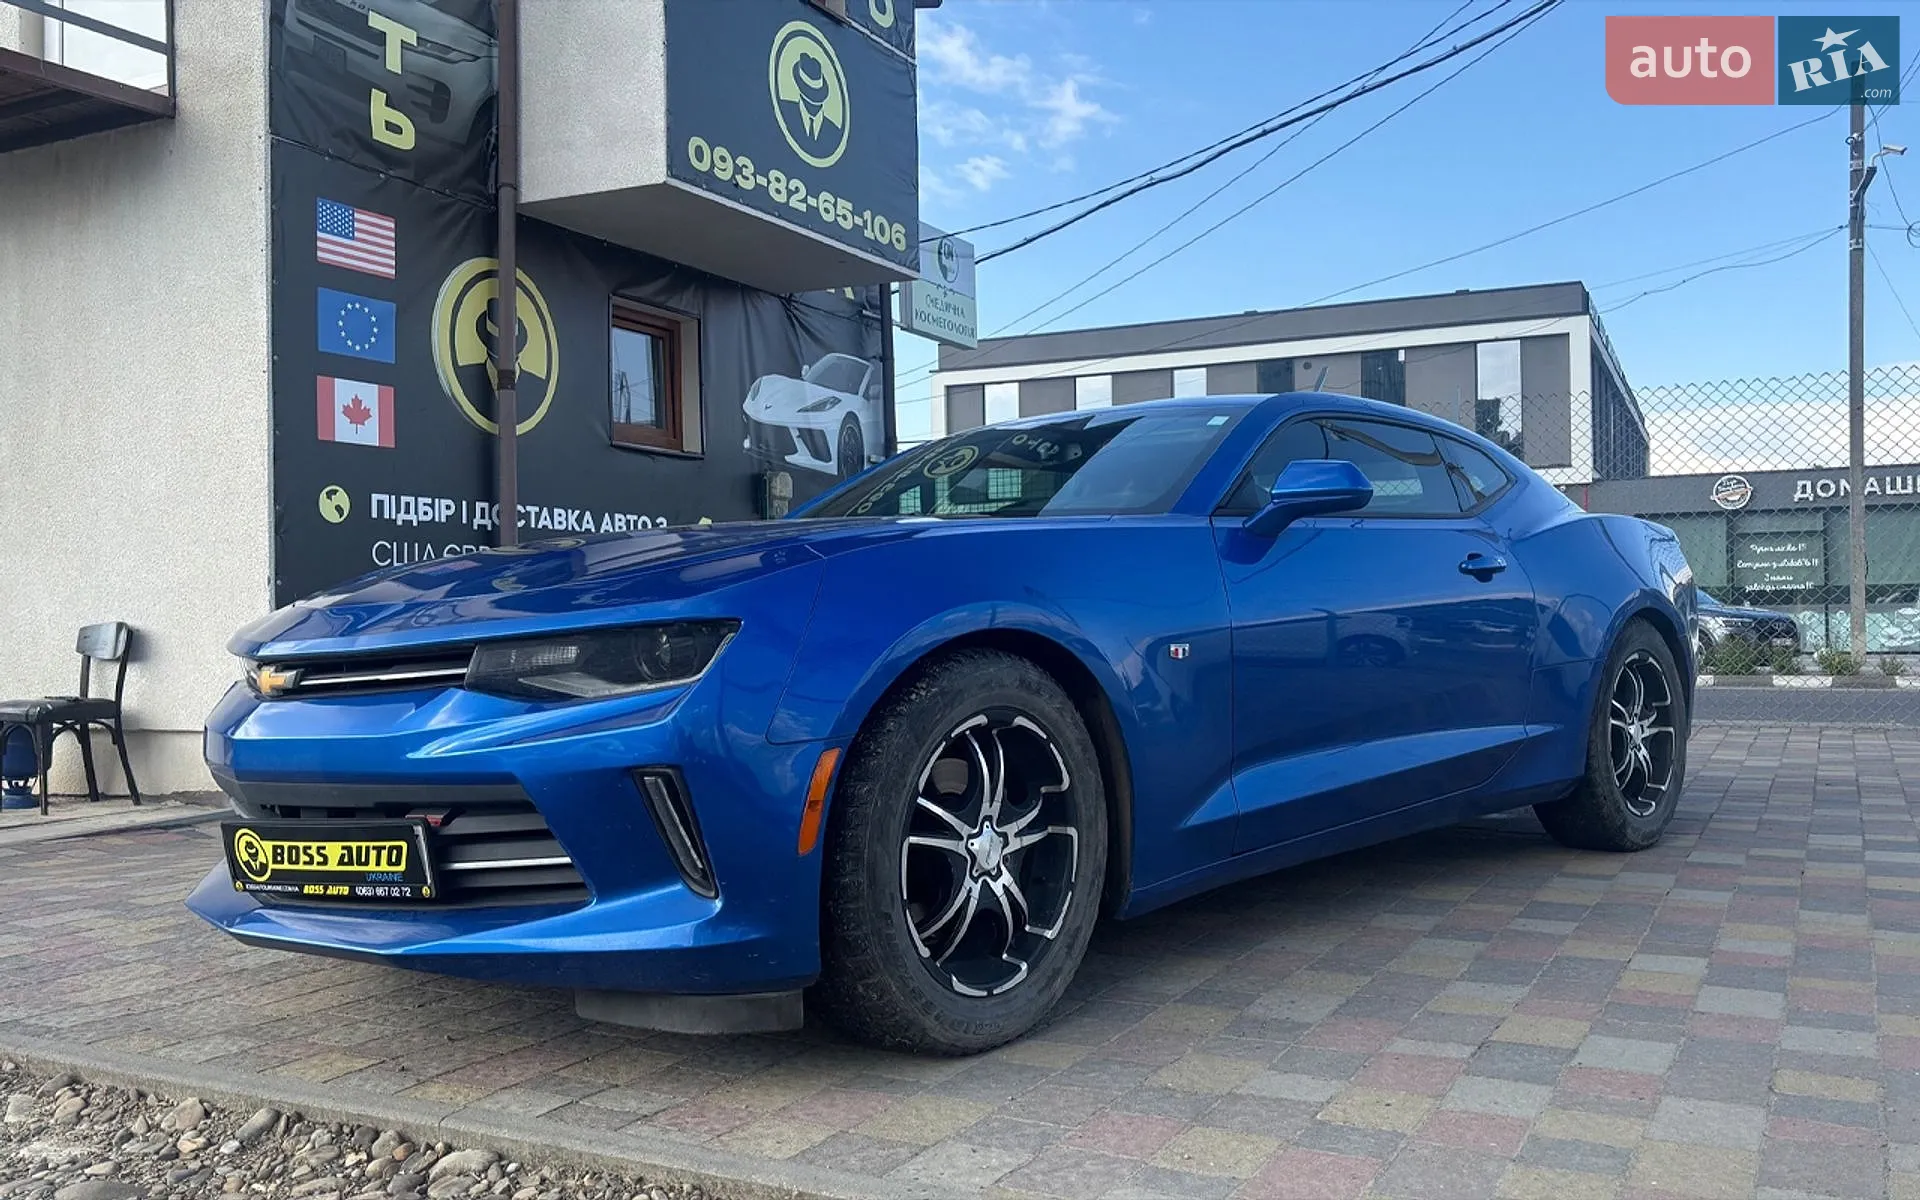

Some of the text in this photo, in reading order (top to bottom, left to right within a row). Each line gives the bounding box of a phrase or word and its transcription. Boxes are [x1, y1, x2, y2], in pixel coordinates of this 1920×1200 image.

[688, 136, 906, 251] 093-82-65-106
[1794, 475, 1920, 502] ДОАШ
[371, 493, 456, 526] ПІДБІР
[600, 513, 651, 533] АВТО
[272, 844, 403, 867] BOSS AUTO
[303, 884, 349, 895] BOSS AUTO
[365, 872, 404, 882] UKRAINE
